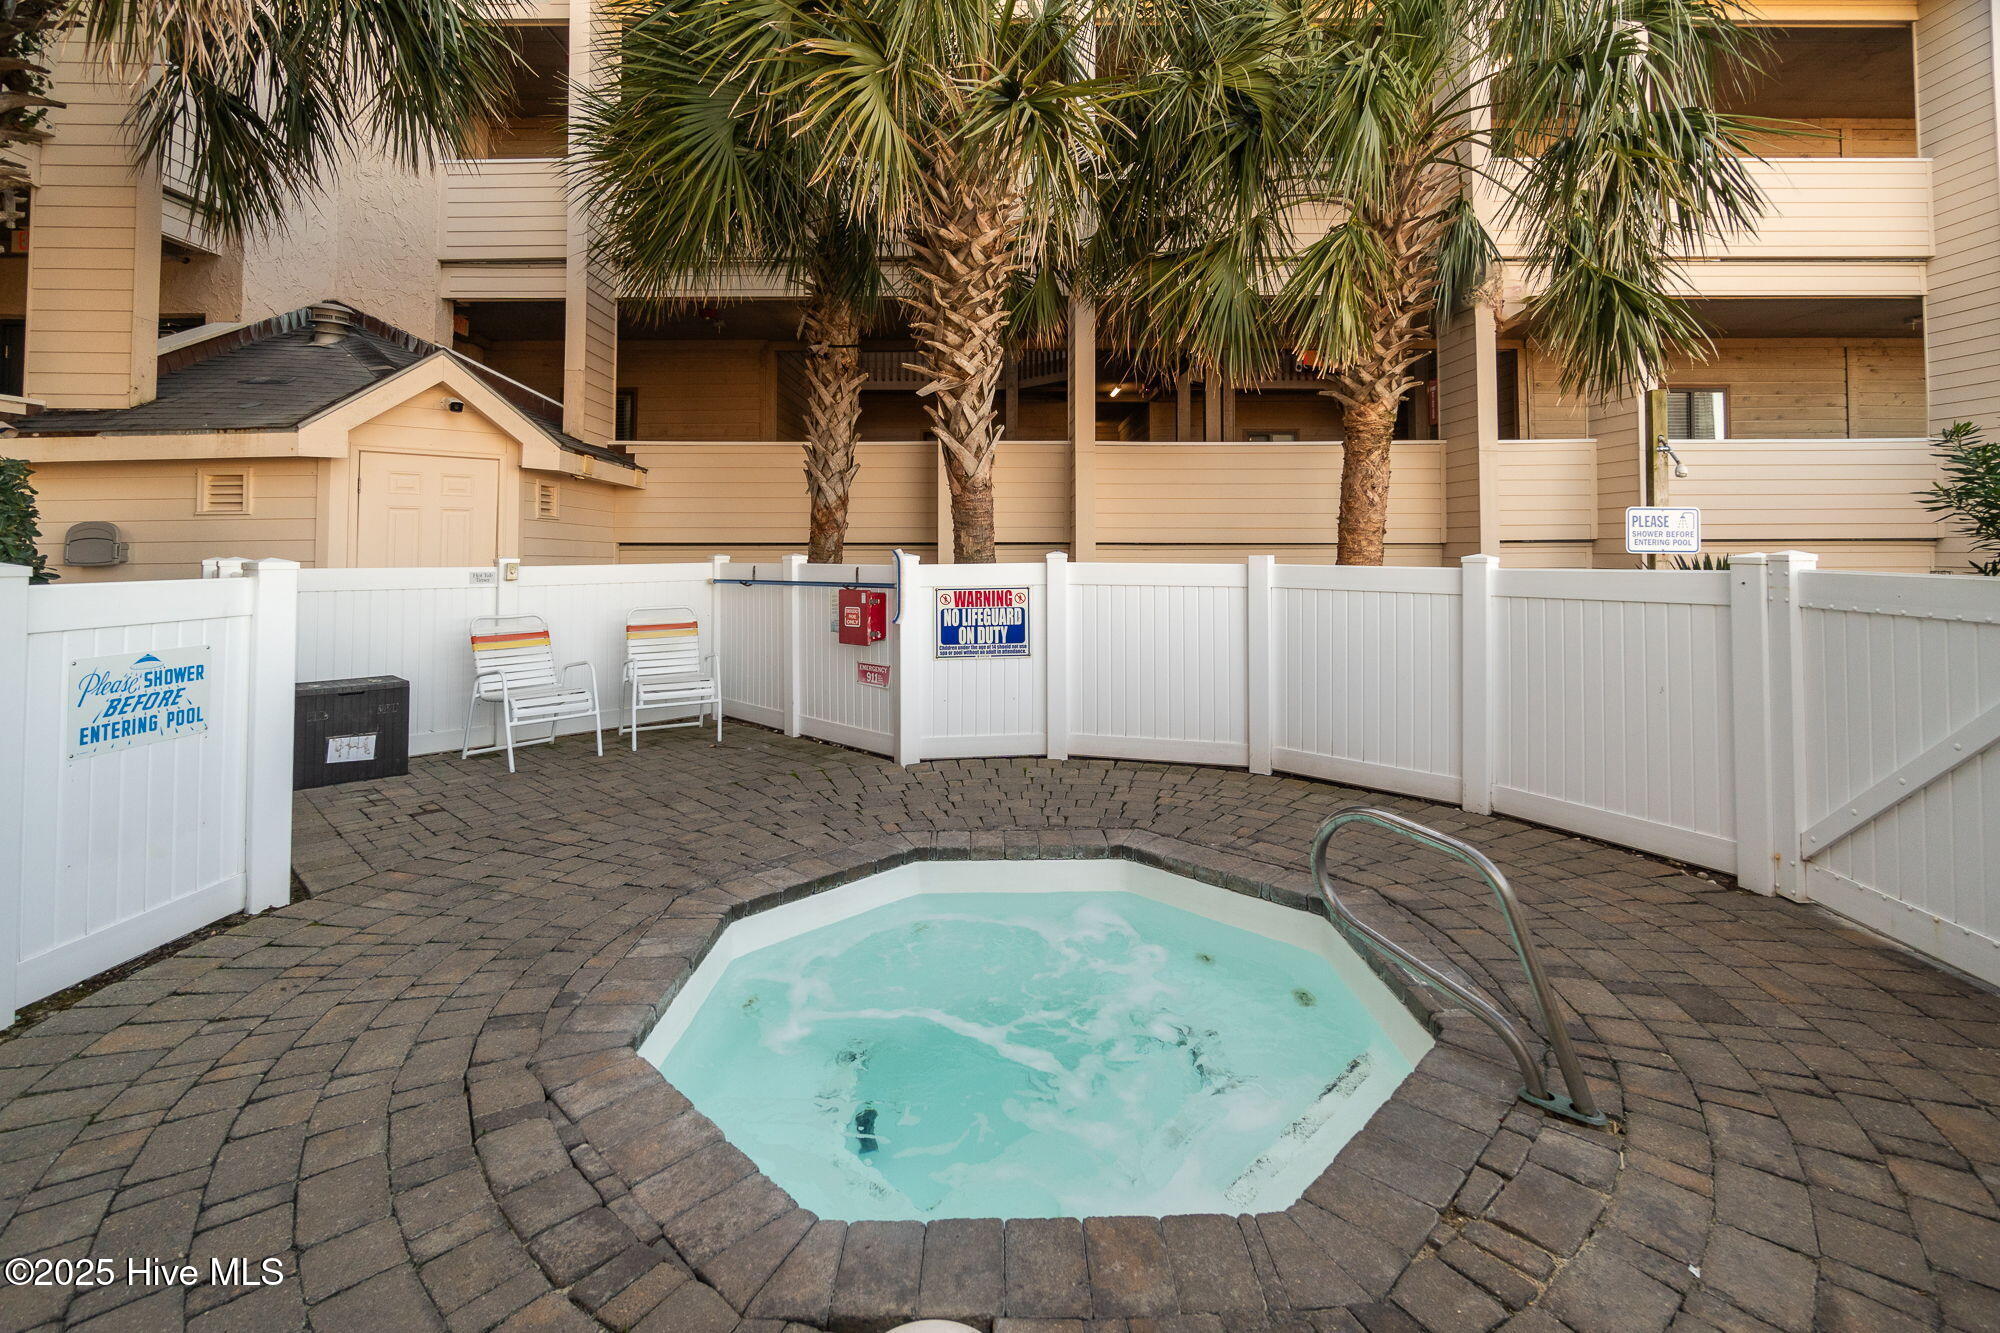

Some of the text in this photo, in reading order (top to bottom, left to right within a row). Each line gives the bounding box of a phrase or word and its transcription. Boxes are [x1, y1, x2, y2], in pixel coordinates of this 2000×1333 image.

[1632, 515, 1669, 528] PLEASE
[1632, 530, 1694, 538] SHOWER BEFORE
[954, 590, 1012, 608] WARNING
[943, 607, 1022, 627] NO LIFEGUARD
[958, 625, 1008, 645] ON DUTY
[859, 664, 888, 674] EMERGENCY
[866, 671, 878, 683] 911
[77, 664, 205, 708] Please SHOWER
[102, 687, 187, 719] BEFORE
[80, 706, 204, 746] ENTERING POOL
